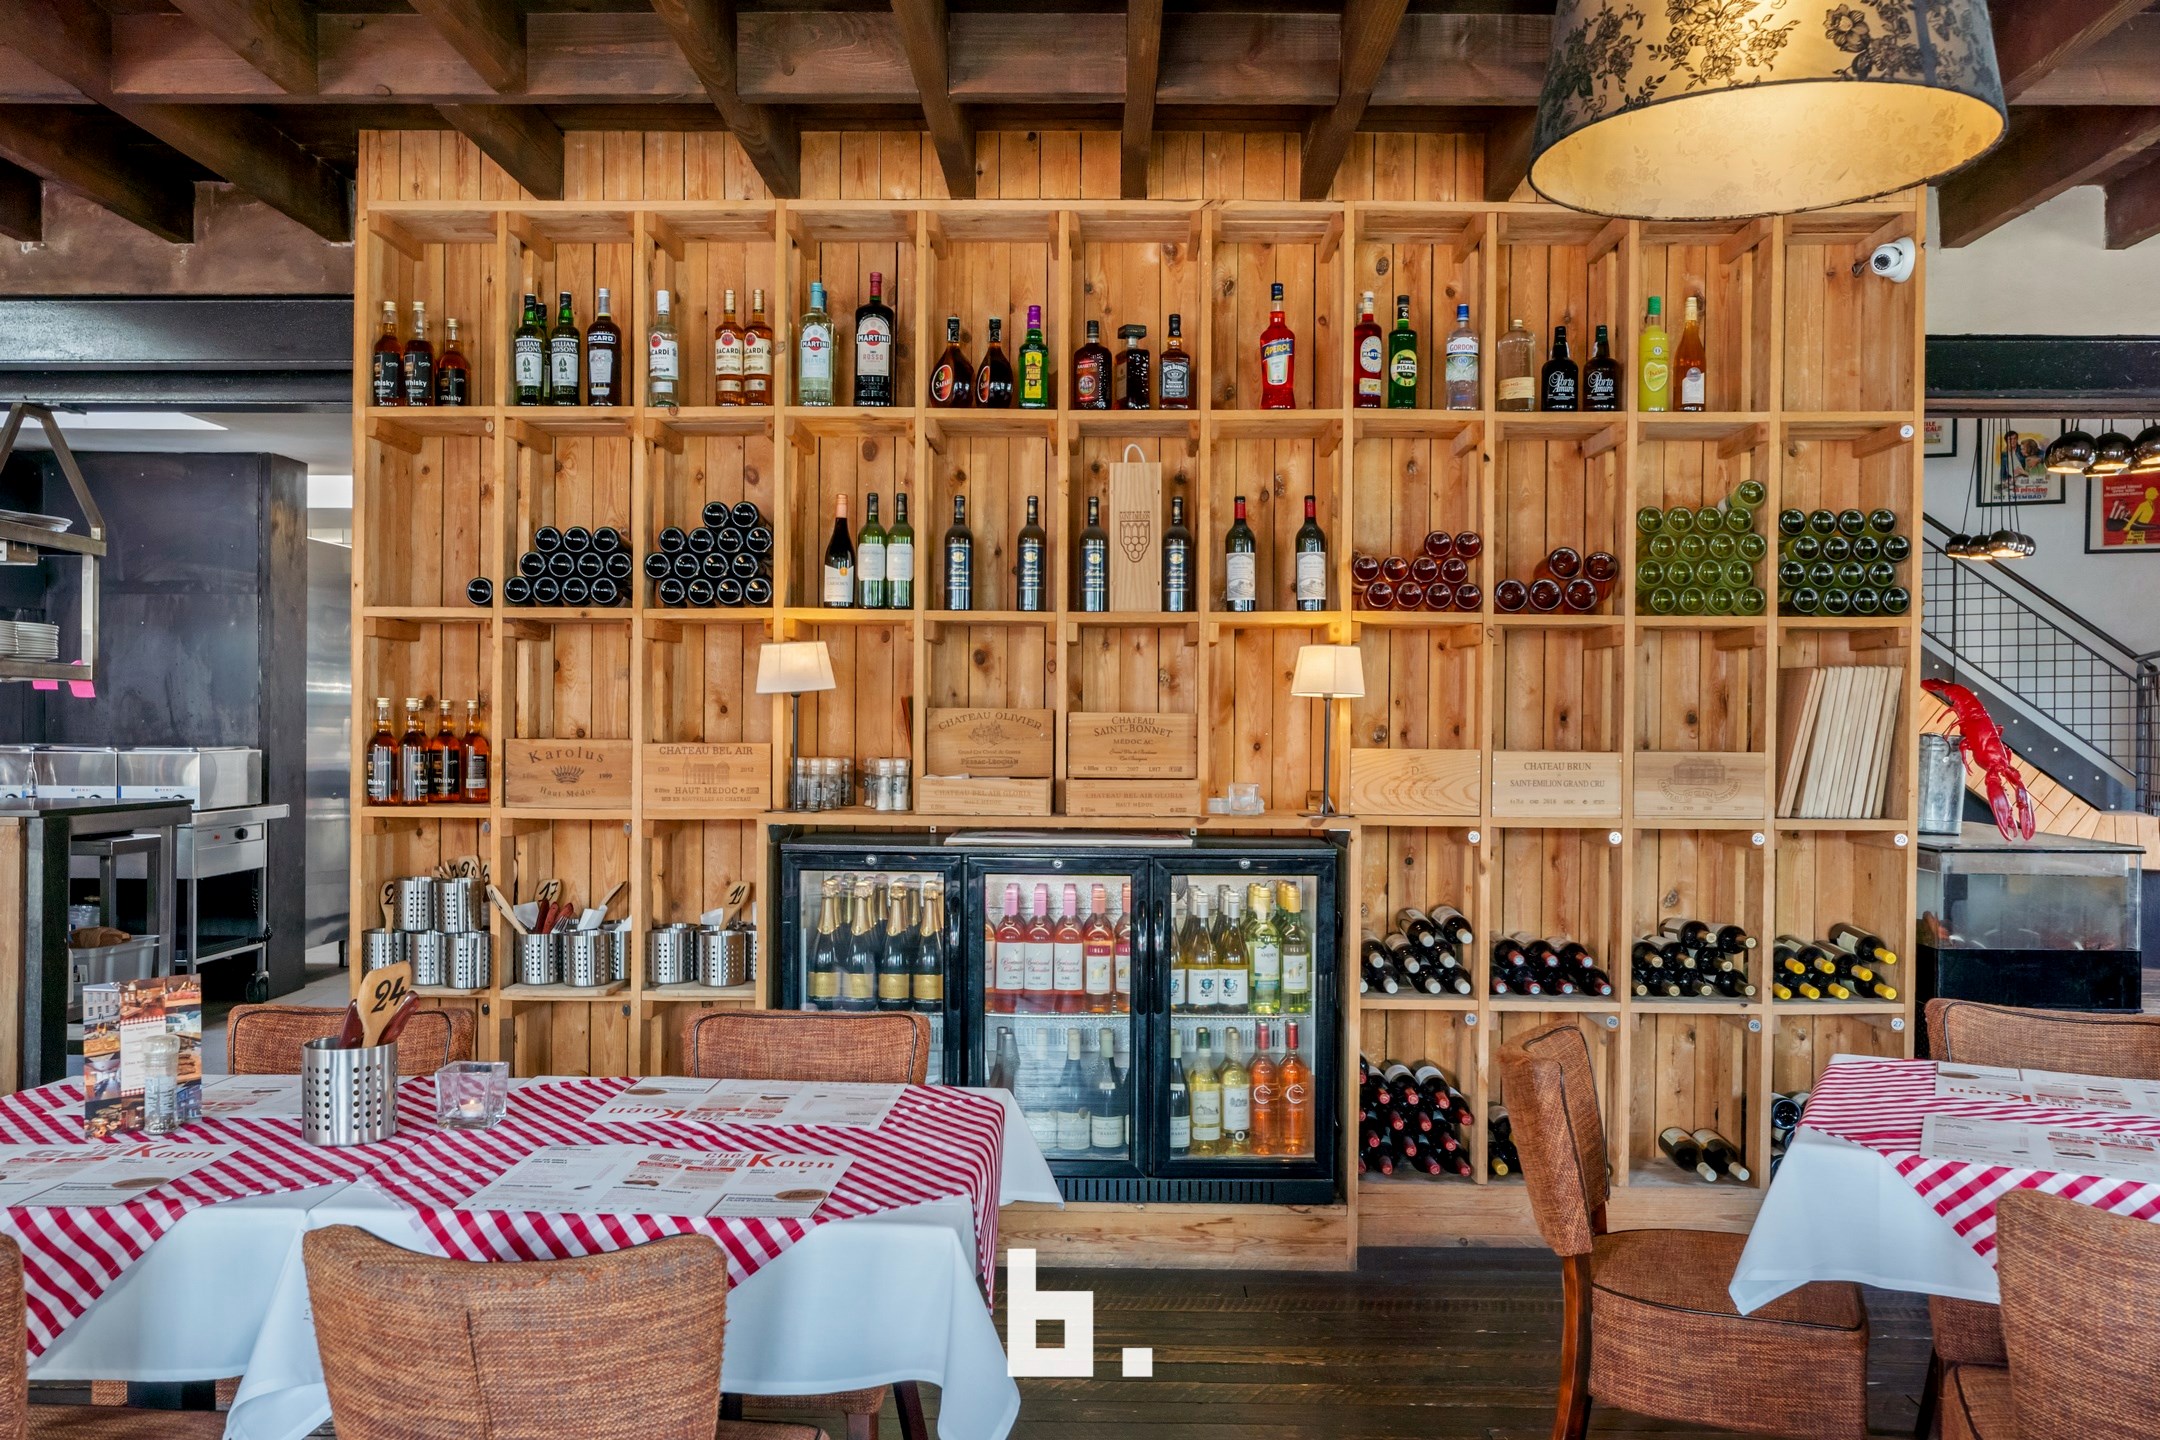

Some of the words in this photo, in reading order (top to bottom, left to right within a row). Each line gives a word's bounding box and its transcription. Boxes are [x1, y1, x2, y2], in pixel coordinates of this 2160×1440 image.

[802, 341, 829, 349] MARTINI
[858, 334, 889, 343] MARTINI
[1264, 344, 1291, 357] APEROL
[1548, 371, 1575, 388] Porto
[1587, 371, 1614, 388] Porto
[938, 712, 991, 731] CHATEAU
[995, 712, 1042, 730] OLIVIER
[1094, 724, 1173, 739] SAINT-BONNET
[528, 746, 605, 764] Karolus
[659, 746, 710, 756] CHATEAU
[712, 746, 732, 756] BEL
[735, 746, 754, 756] AIR
[1524, 762, 1565, 771] CHATEAU
[1567, 762, 1592, 771] BRUN
[1509, 779, 1562, 788] SAINT-EMILION
[1563, 780, 1589, 788] GRAND
[1590, 780, 1605, 788] CRU
[675, 786, 701, 795] HAUT
[1754, 835, 1763, 843] 22
[1896, 835, 1906, 843] 23
[538, 882, 559, 902] 17
[728, 885, 746, 905] 11
[371, 976, 407, 1013] 24
[1893, 1020, 1902, 1028] 27
[608, 1107, 687, 1119] Koen
[124, 1144, 215, 1158] Koen
[746, 1153, 834, 1169] Koen
